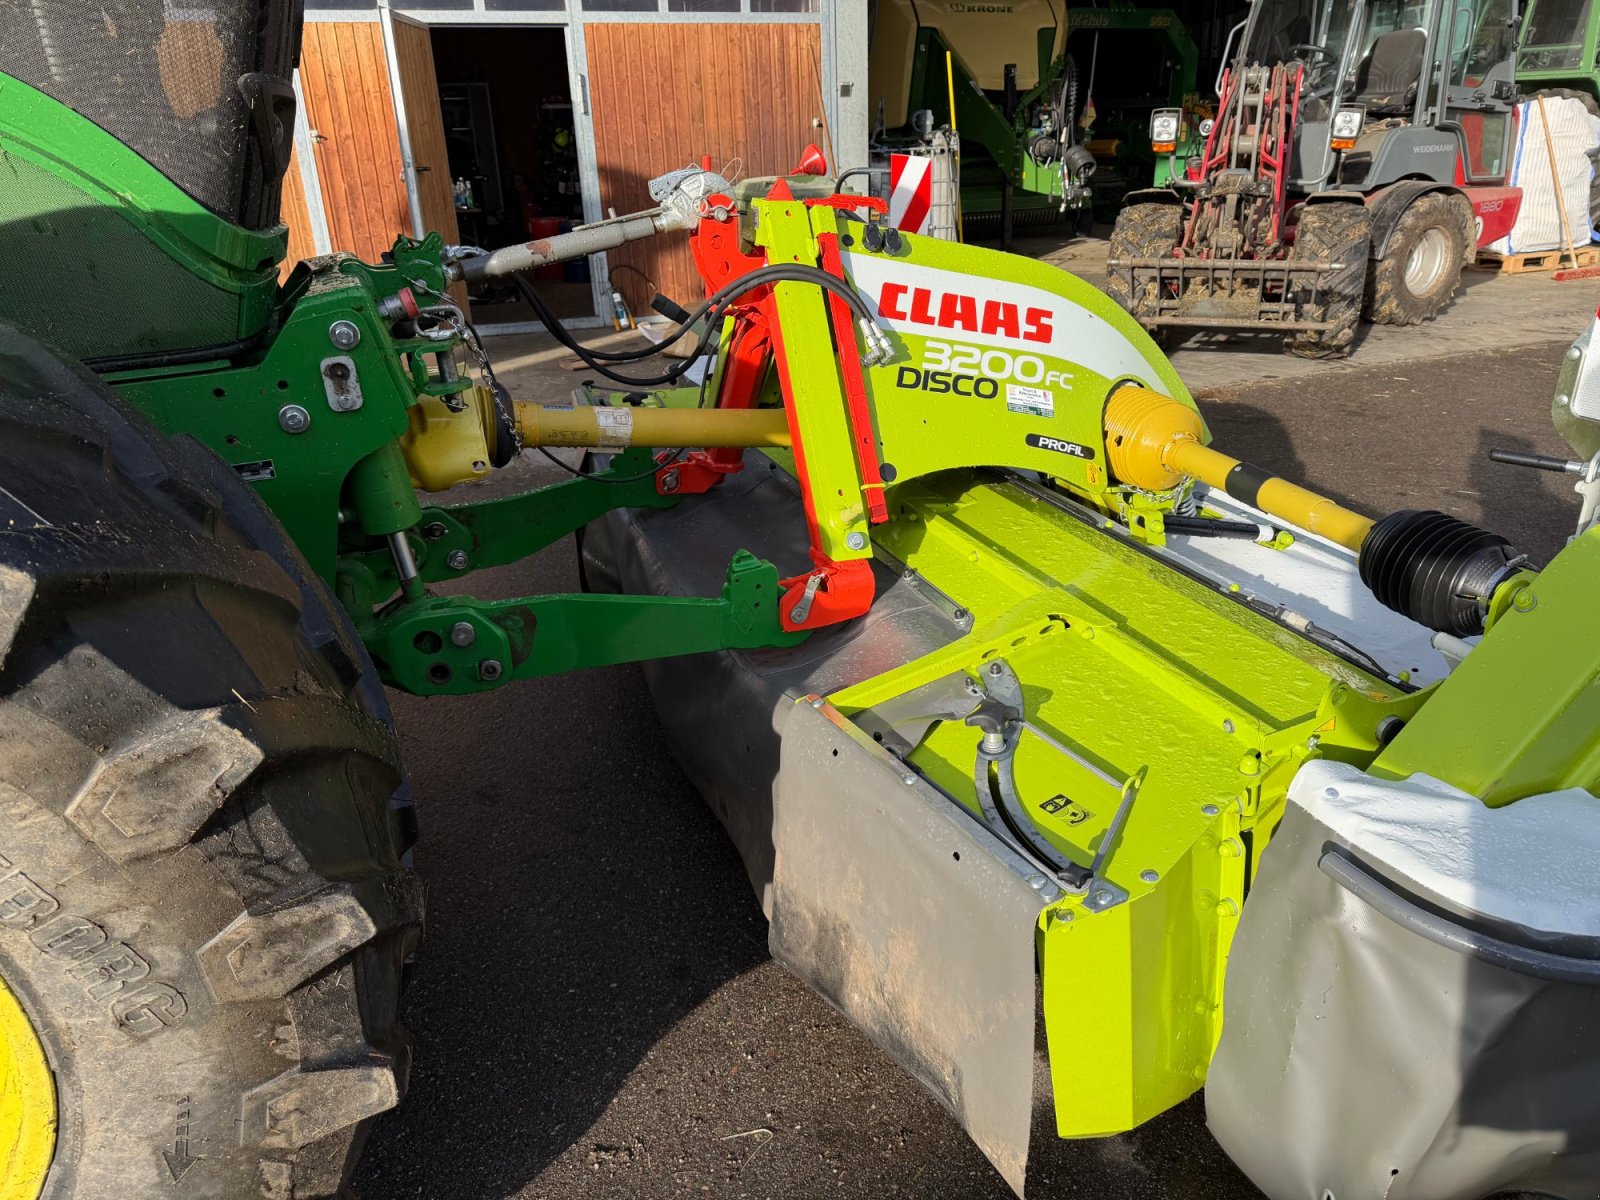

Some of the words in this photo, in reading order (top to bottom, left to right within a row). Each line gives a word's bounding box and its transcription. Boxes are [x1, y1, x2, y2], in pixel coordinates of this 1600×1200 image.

[967, 5, 1014, 13] KRONE
[1413, 144, 1454, 154] WEIDEMANN
[1479, 200, 1504, 213] 1880
[878, 282, 1054, 344] CLAAS
[897, 367, 999, 398] DISCO
[1038, 436, 1085, 457] PROFIL
